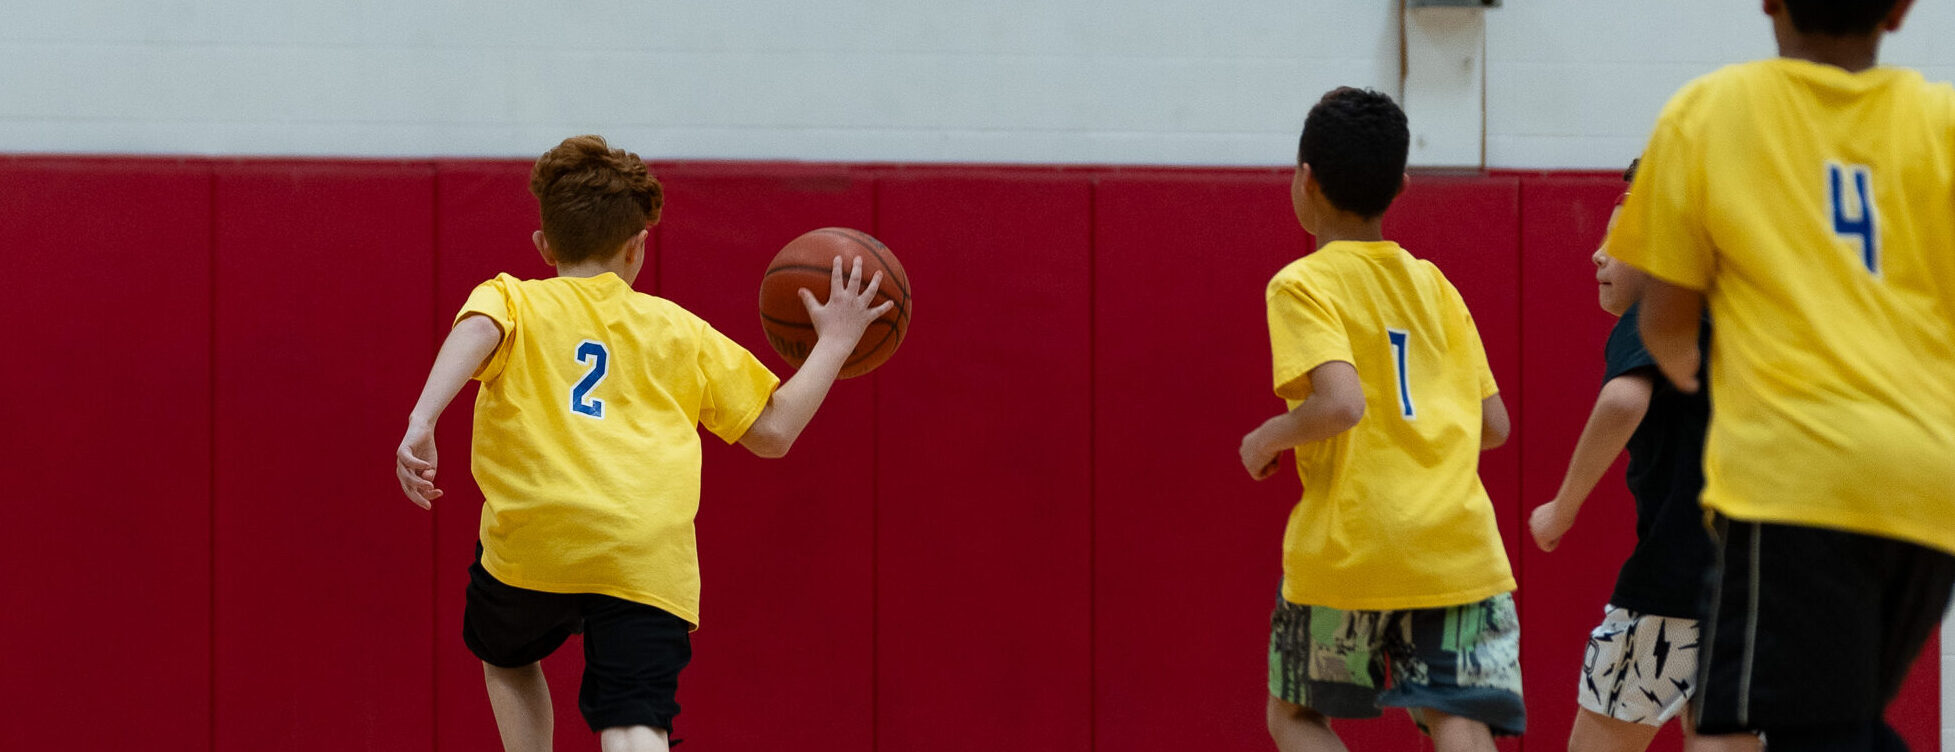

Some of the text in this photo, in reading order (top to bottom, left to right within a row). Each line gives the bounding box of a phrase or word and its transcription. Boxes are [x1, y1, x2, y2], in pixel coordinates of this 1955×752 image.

[1824, 160, 1881, 277] 4
[569, 339, 609, 419] 2
[1387, 327, 1416, 420] 1
